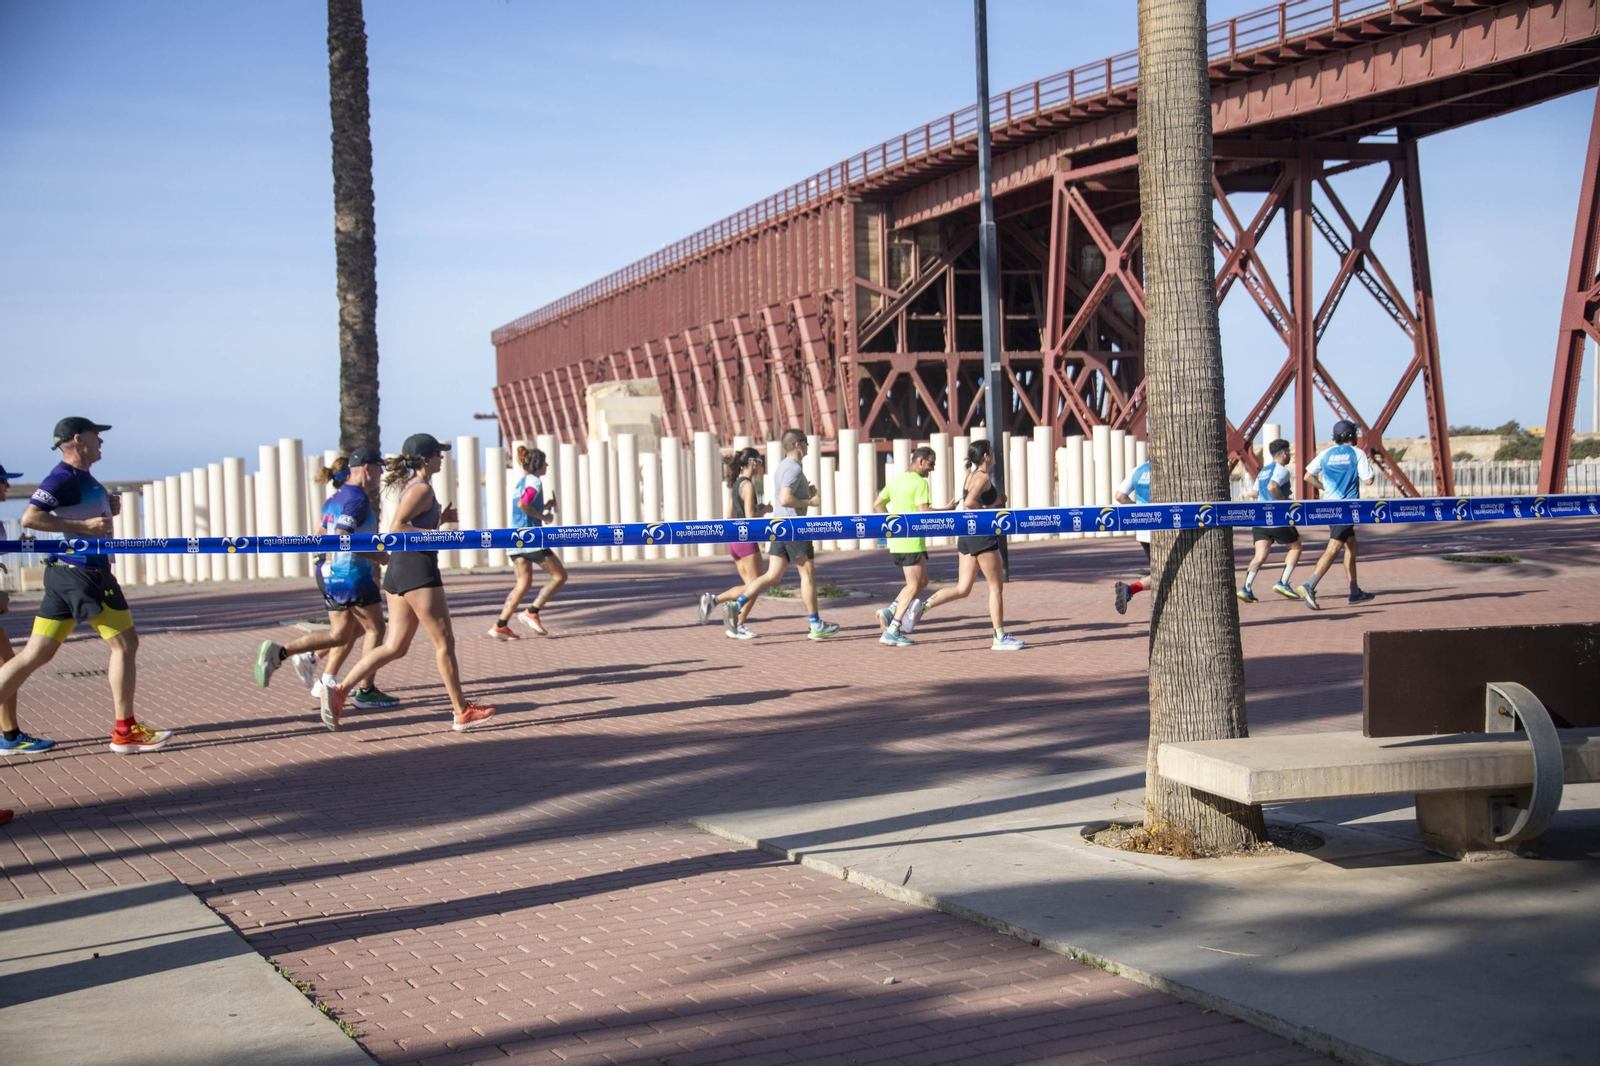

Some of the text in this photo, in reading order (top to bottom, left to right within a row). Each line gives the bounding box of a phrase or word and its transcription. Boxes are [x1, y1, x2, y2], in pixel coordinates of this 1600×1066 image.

[1020, 520, 1061, 528] Ayuntamiento
[1122, 517, 1162, 525] Ayuntamiento
[797, 526, 843, 534] Ayuntamiento
[912, 523, 955, 531] Ayuntamiento
[547, 532, 599, 540] Ayuntamiento
[676, 529, 724, 537] Ayuntamiento
[263, 537, 322, 546] Ayuntamiento
[410, 534, 465, 543] Ayuntamiento
[105, 539, 168, 549] Ayuntamiento
